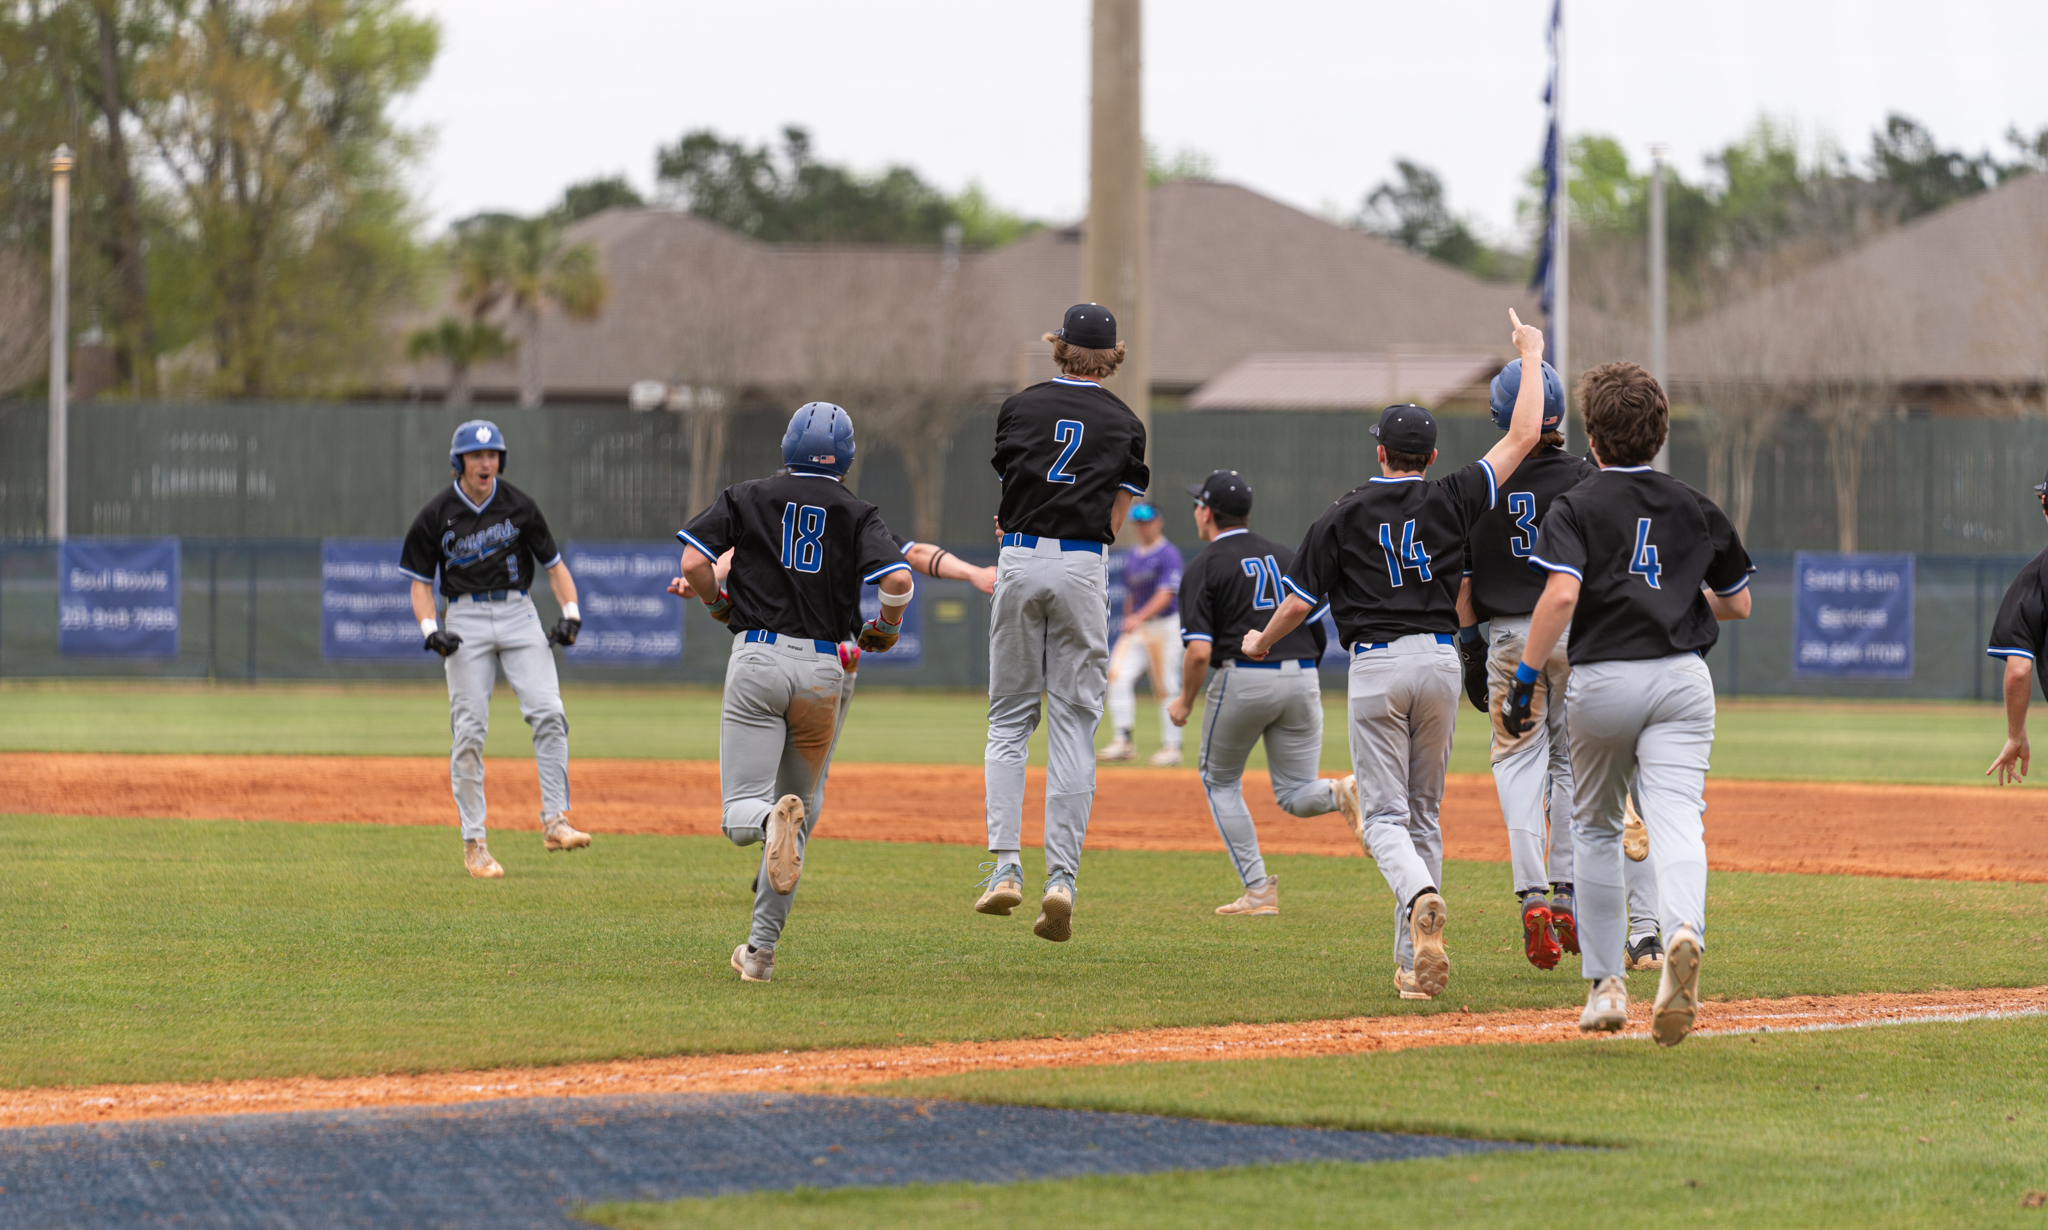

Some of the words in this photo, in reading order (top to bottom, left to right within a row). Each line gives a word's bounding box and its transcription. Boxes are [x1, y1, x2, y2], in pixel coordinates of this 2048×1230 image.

[1046, 419, 1084, 484] 2
[442, 518, 520, 562] Cougars
[781, 501, 827, 574] 18
[1379, 518, 1433, 587] 14
[1508, 492, 1539, 557] 3
[1628, 517, 1662, 590] 4
[70, 567, 110, 592] Soul
[1241, 555, 1286, 610] 21
[1803, 568, 1846, 592] Sand
[1862, 568, 1900, 593] Sun
[1817, 604, 1888, 629] Services
